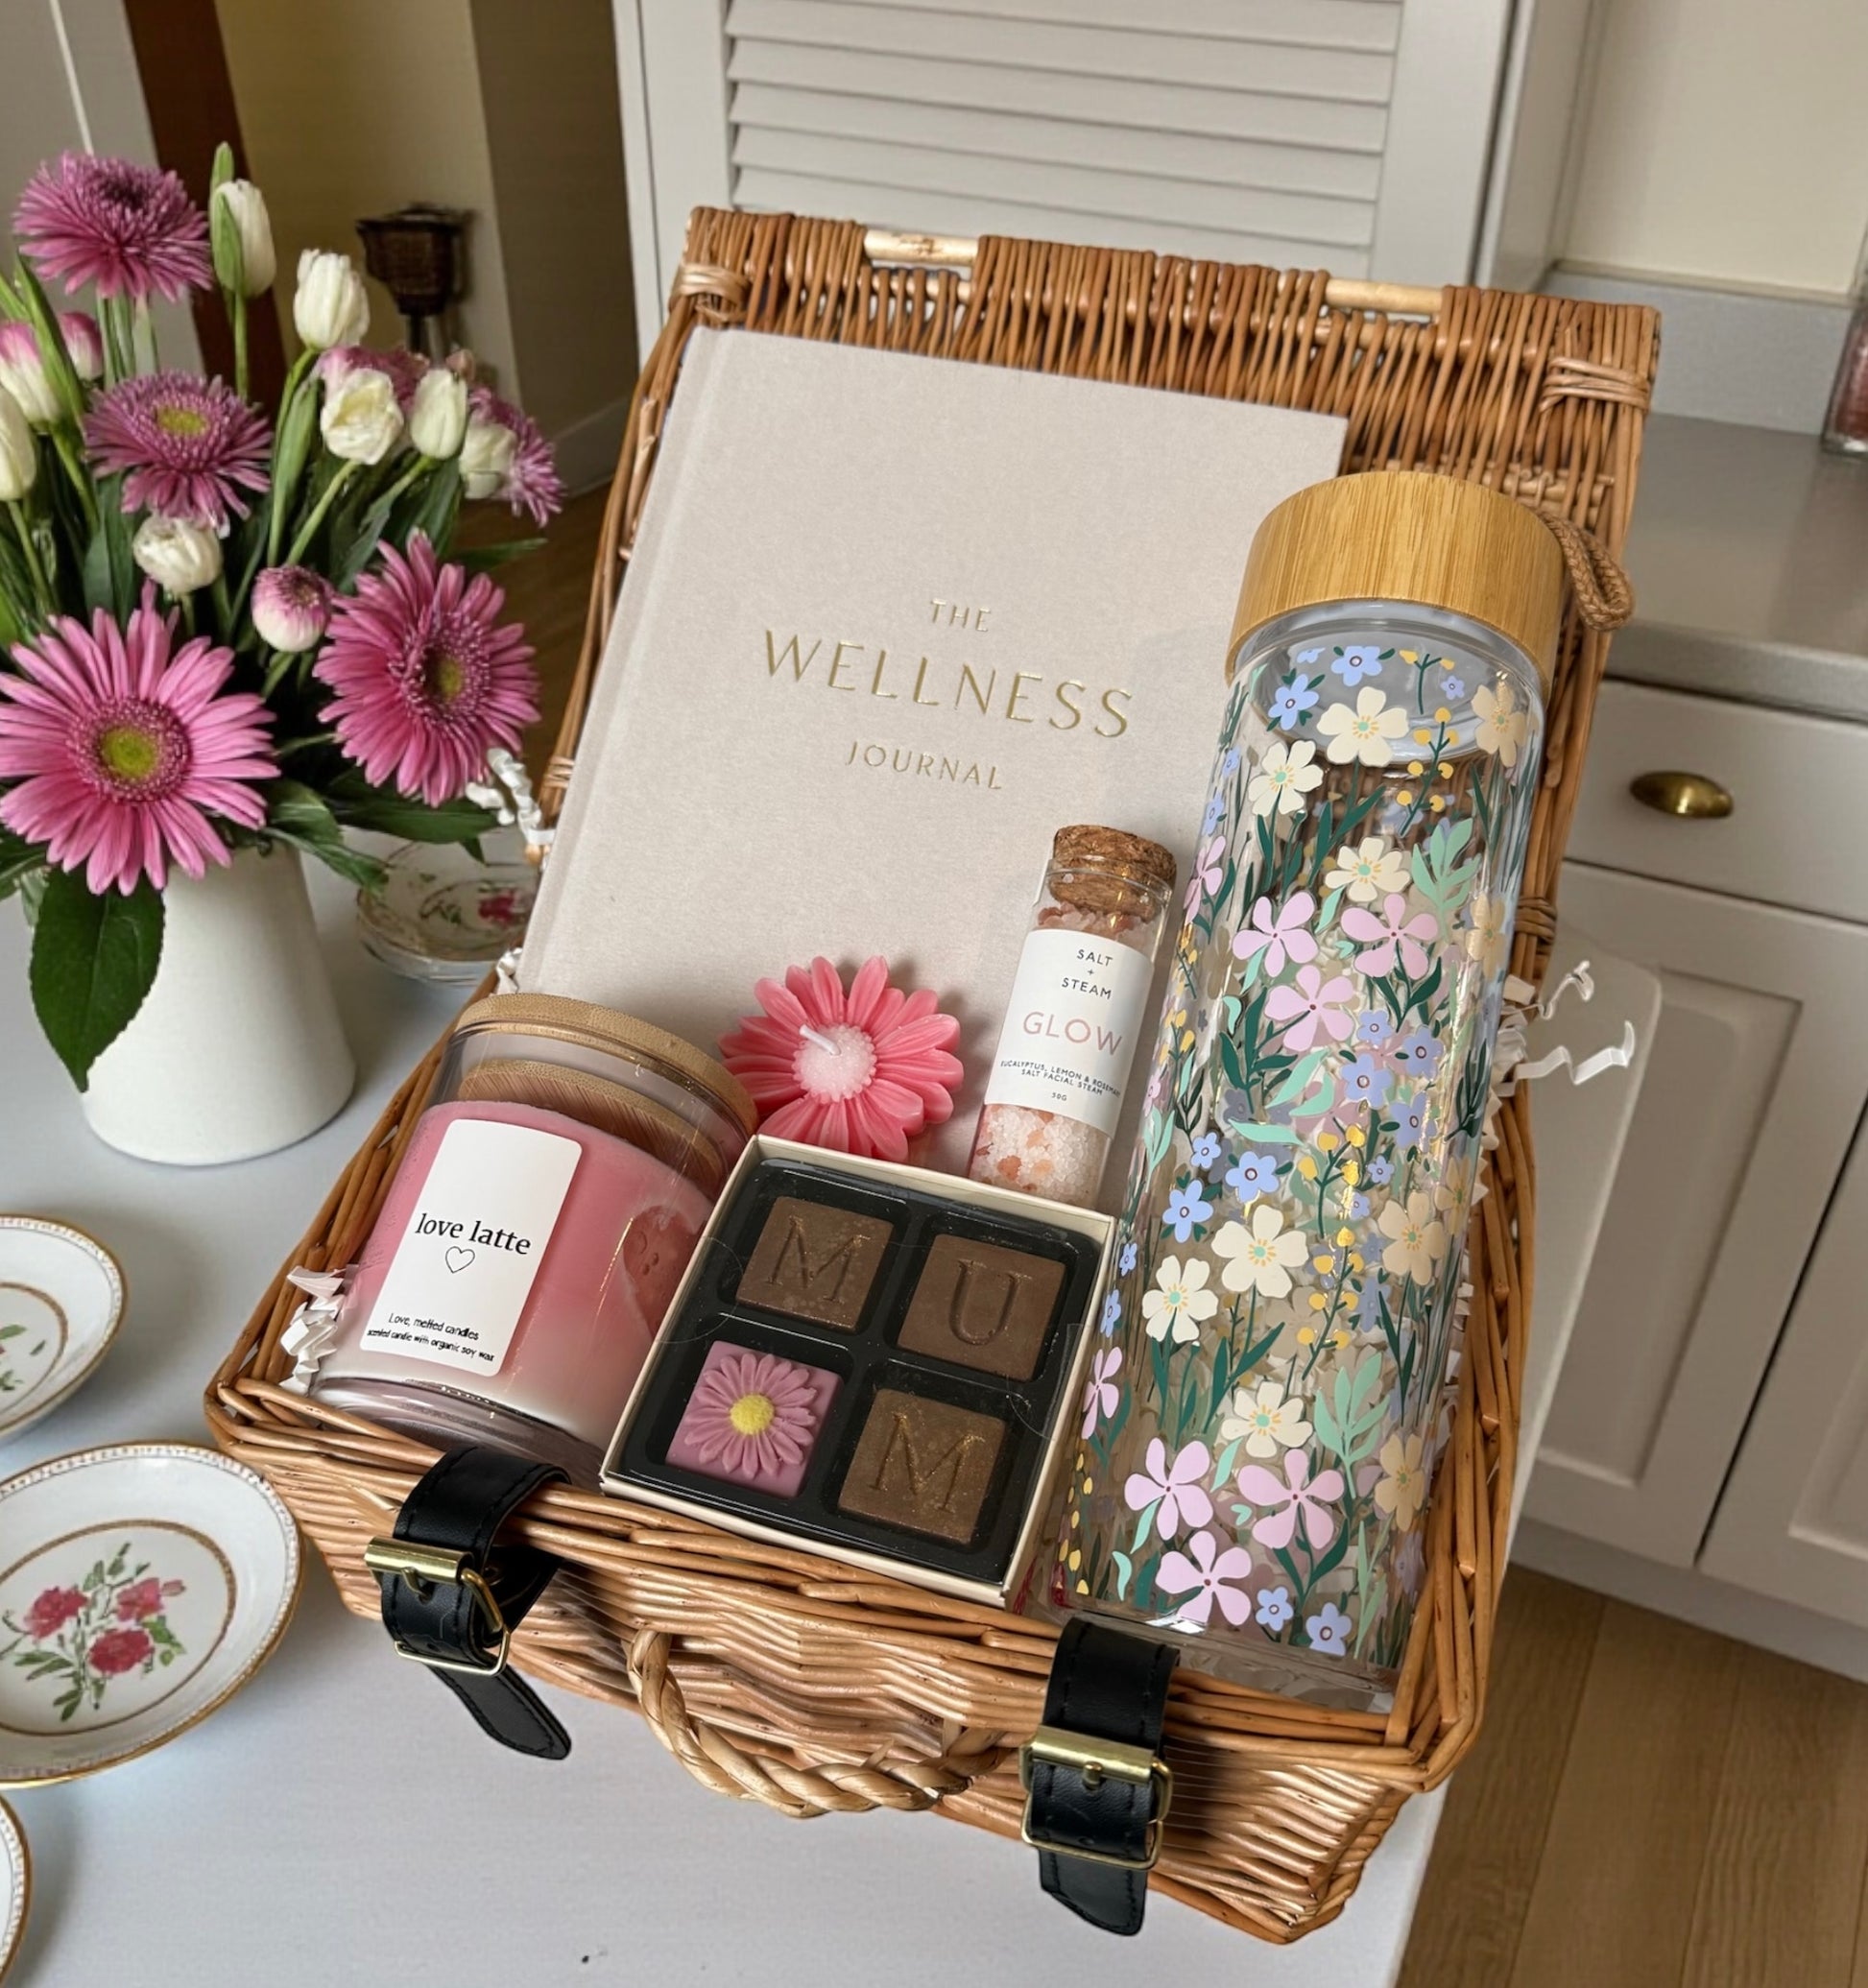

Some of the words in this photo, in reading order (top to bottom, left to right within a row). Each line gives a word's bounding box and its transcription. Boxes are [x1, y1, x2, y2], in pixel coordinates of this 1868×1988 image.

[930, 597, 992, 633] THE
[765, 629, 1133, 738] WELLNESS
[846, 740, 1002, 791] JOURNAL
[1076, 948, 1114, 968] SALT
[1061, 977, 1113, 1000] STEAM
[1022, 1011, 1123, 1056] GLOW
[1020, 1068, 1042, 1078] SALT
[1042, 1071, 1074, 1087] FACIAL
[1077, 1081, 1103, 1096] STEAM
[1050, 1066, 1083, 1081] LEMON
[1084, 1075, 1090, 1084] &
[414, 1212, 465, 1239] love
[468, 1220, 532, 1256] latte
[769, 1213, 872, 1303] M
[948, 1258, 1033, 1346] U
[388, 1312, 411, 1328] Love,
[444, 1325, 480, 1341] candles
[430, 1338, 461, 1351] organic
[461, 1346, 477, 1359] soy
[868, 1409, 987, 1514] M
